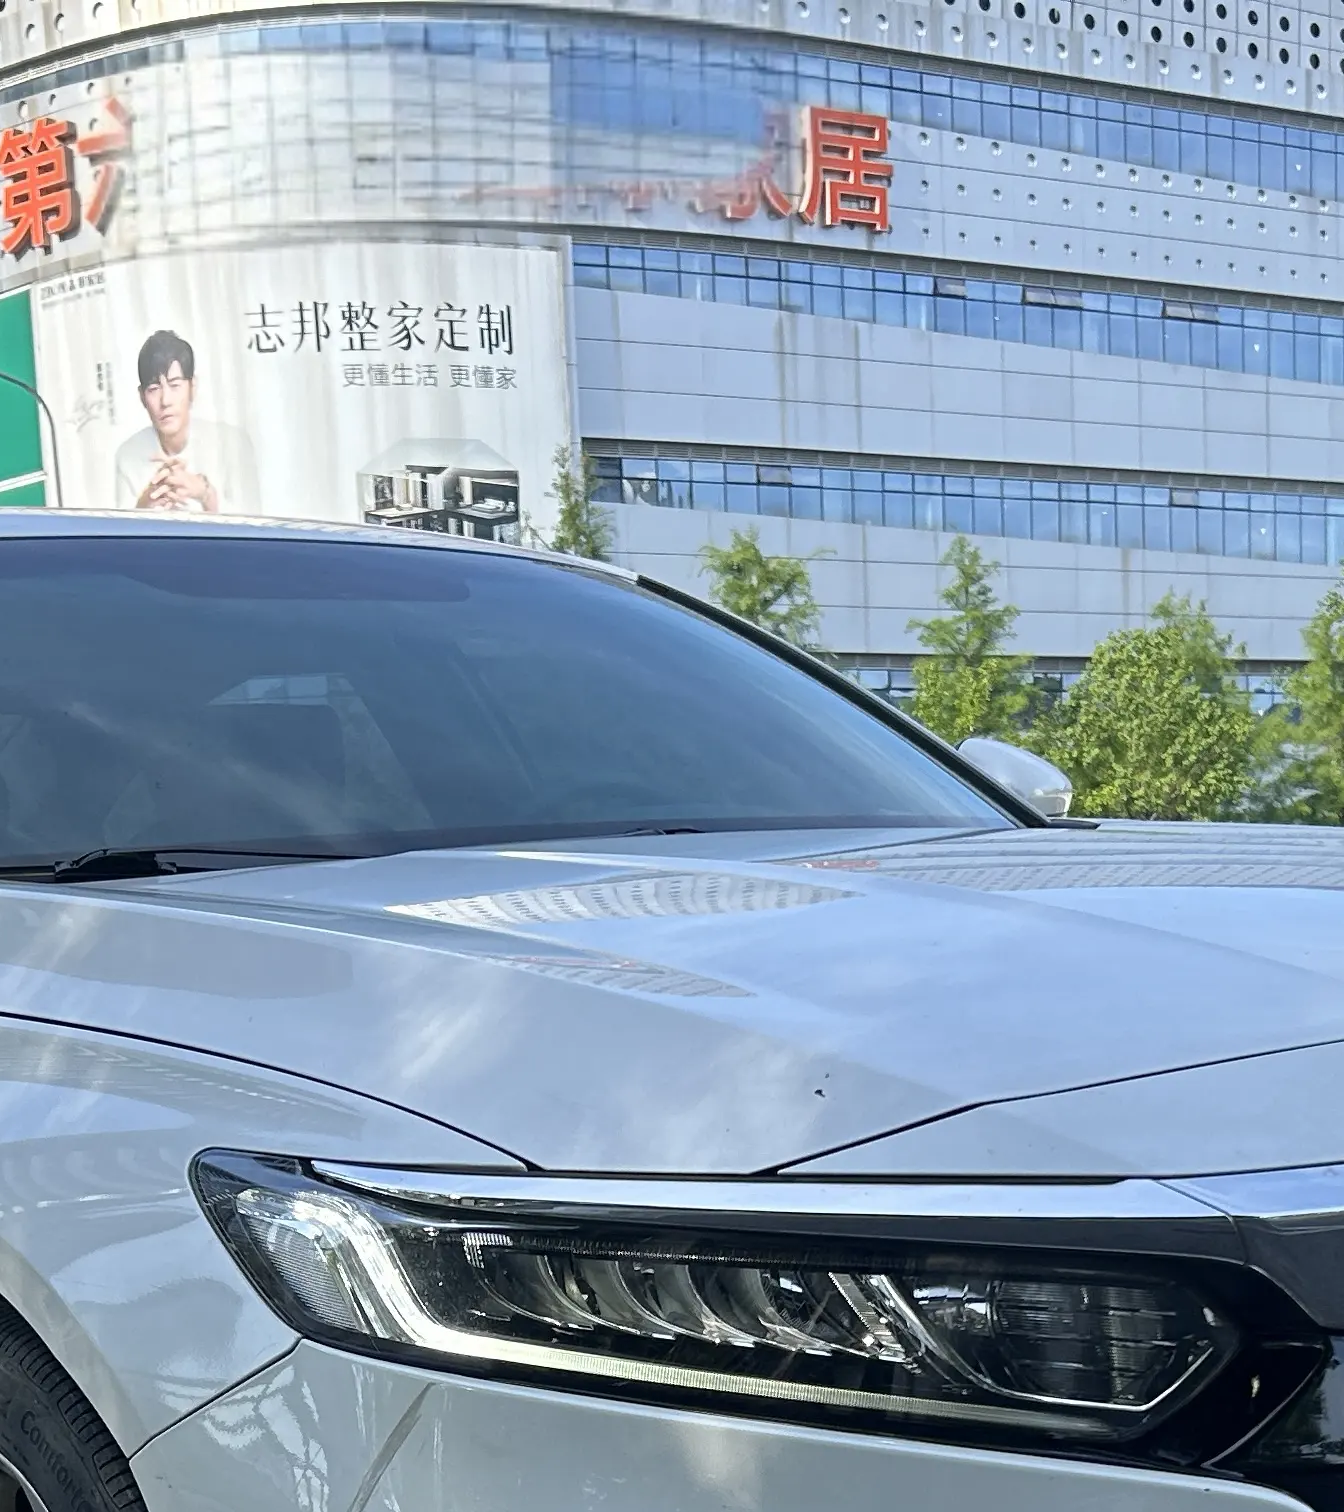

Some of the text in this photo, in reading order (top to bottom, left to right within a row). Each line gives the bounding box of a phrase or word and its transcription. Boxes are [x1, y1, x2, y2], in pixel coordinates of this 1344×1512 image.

[244, 301, 514, 355] 志邦整家定制
[342, 363, 518, 389] 更懂生活 更懂家
